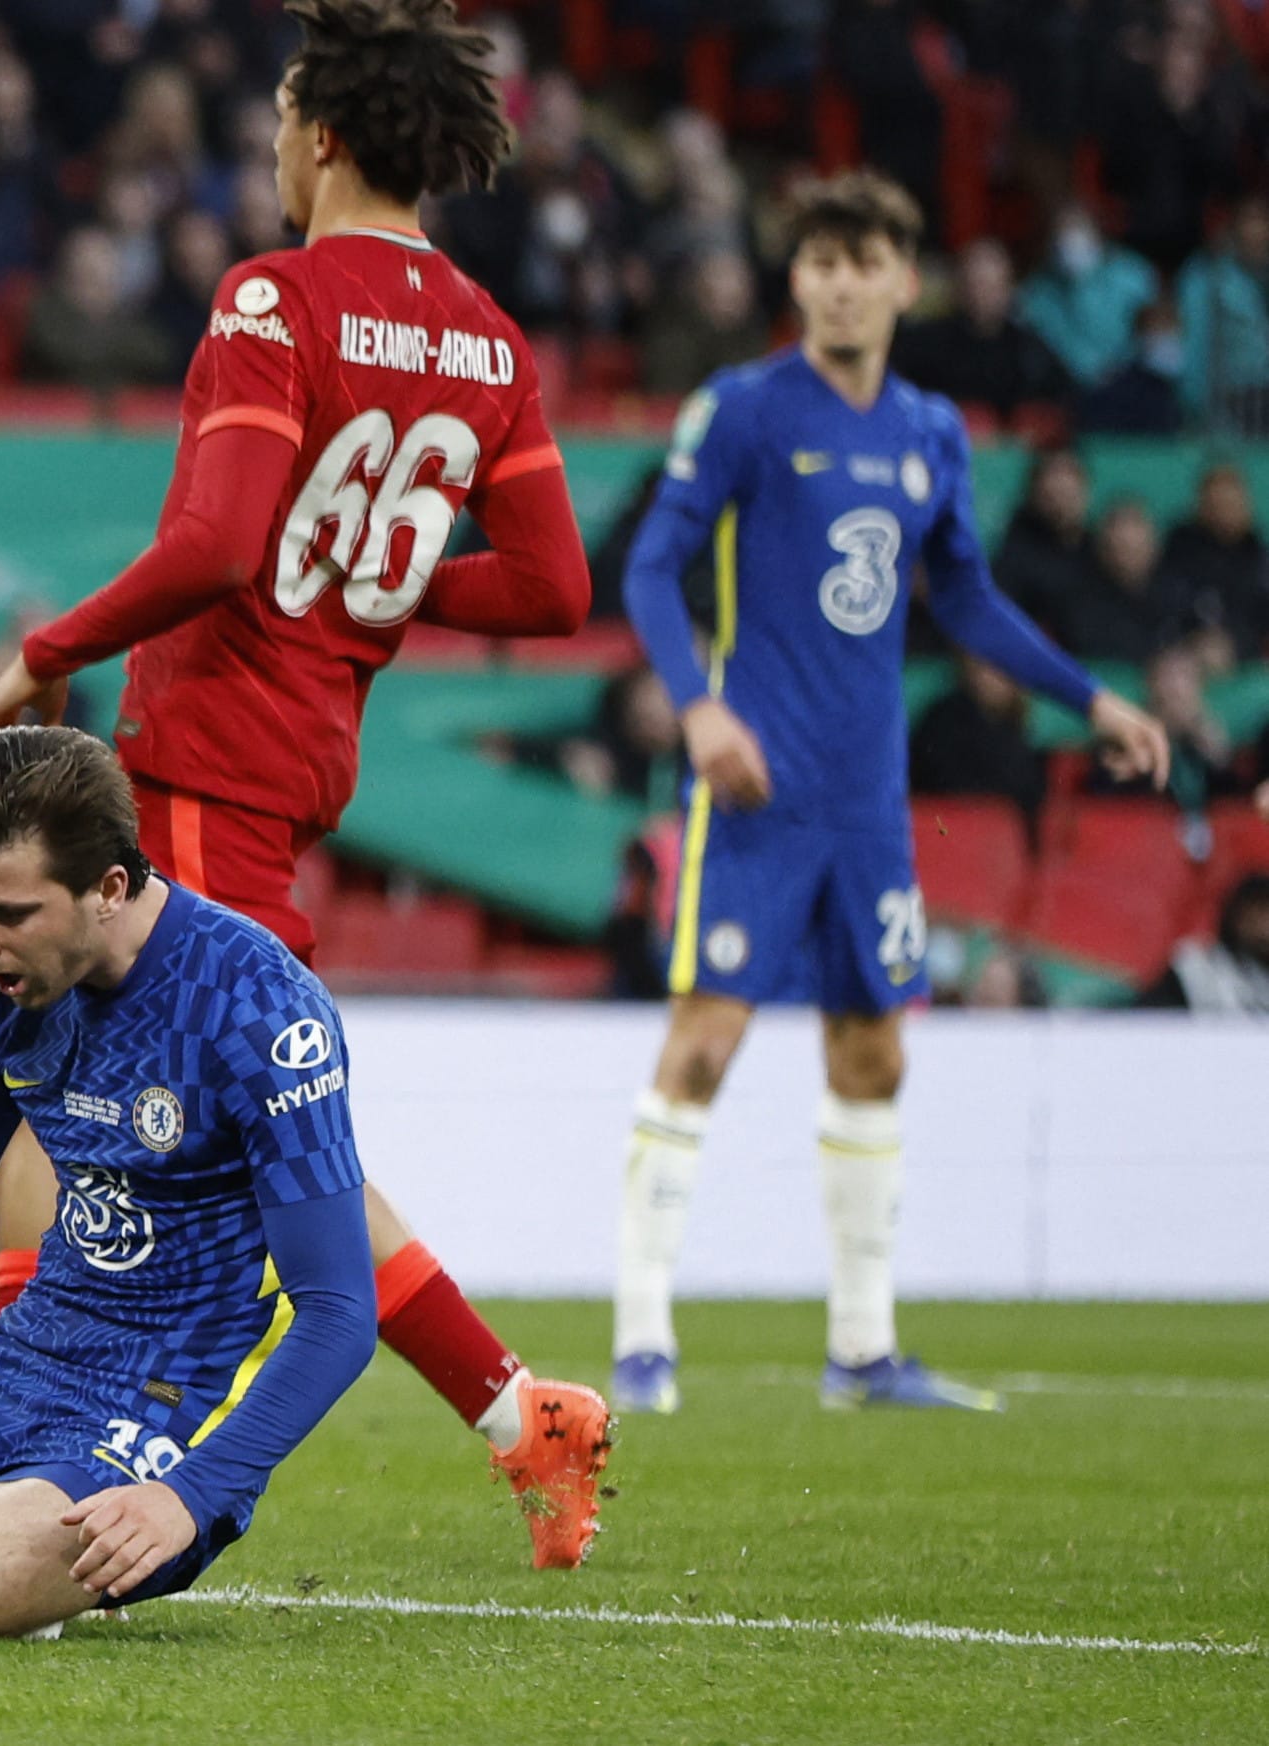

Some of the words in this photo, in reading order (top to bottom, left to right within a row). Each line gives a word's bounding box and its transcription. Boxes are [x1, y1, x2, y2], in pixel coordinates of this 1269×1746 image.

[339, 312, 514, 386] ALEXANDR-ARNOLD
[275, 408, 481, 628] 66
[818, 506, 902, 636] 3
[266, 1065, 345, 1117] HYUND
[98, 1418, 185, 1485] 19
